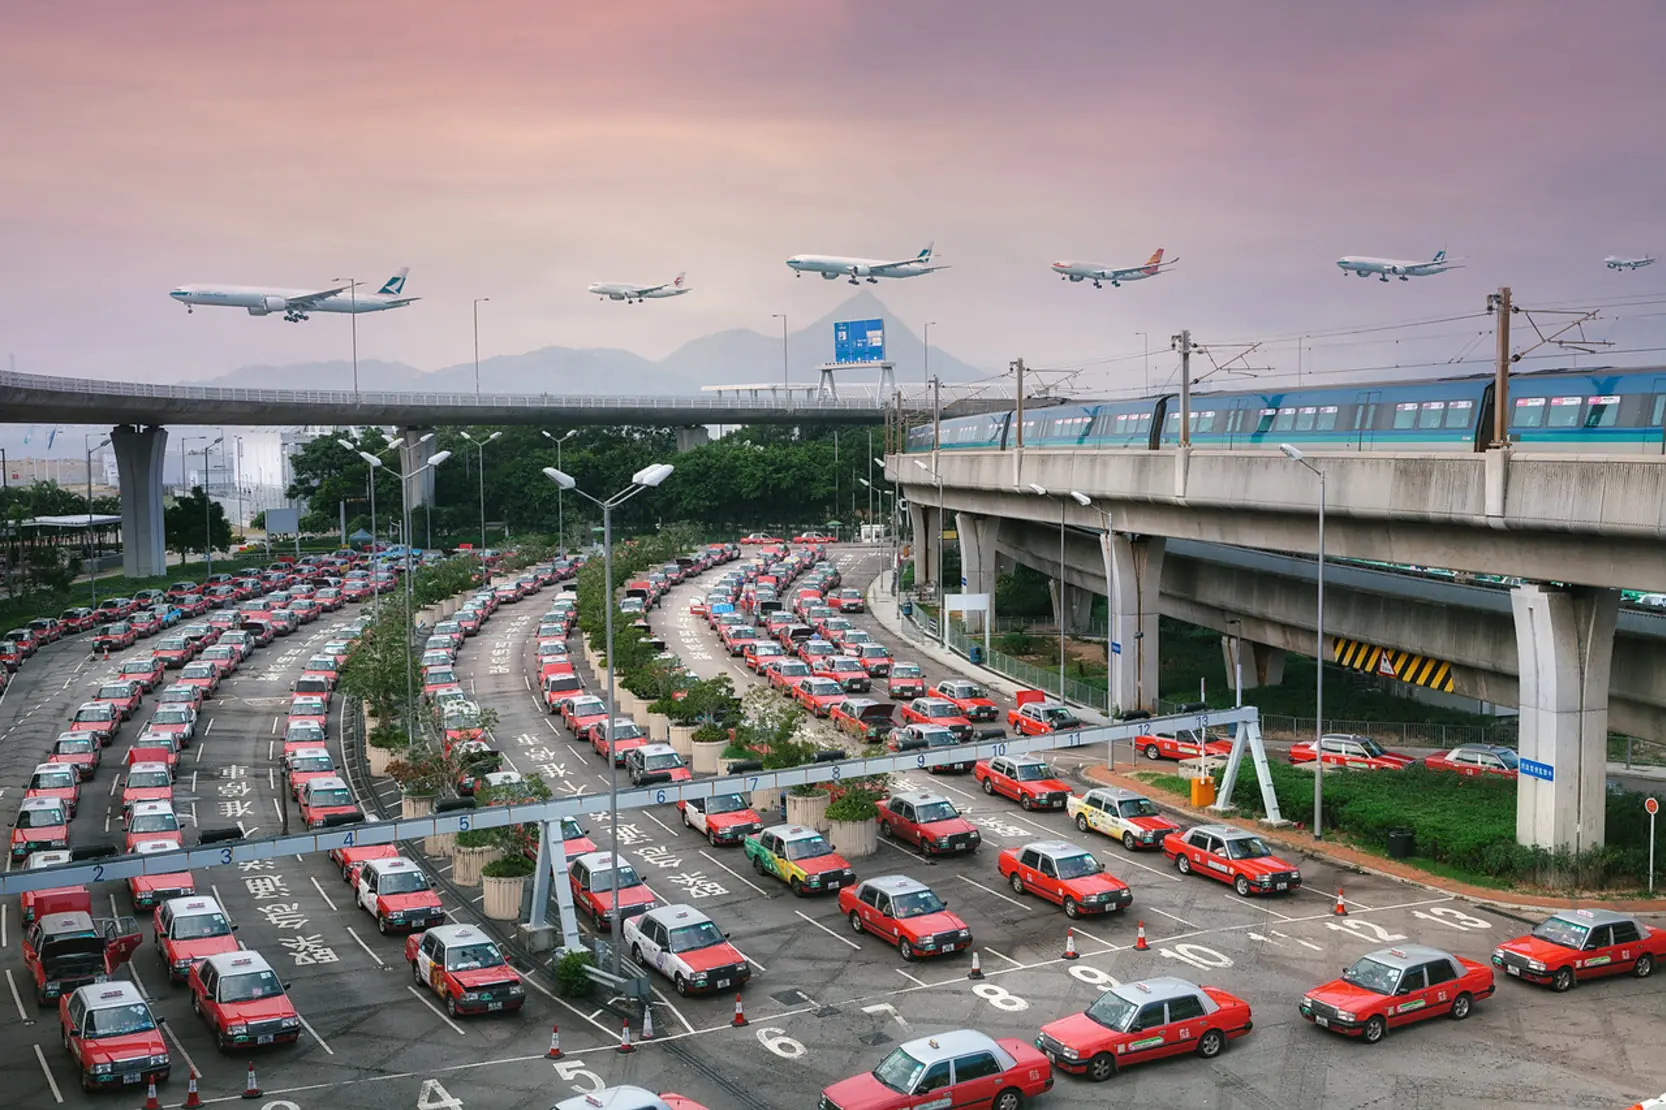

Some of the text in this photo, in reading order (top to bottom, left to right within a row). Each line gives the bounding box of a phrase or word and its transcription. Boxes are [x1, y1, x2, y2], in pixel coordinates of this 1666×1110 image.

[1138, 721, 1151, 736] 12
[1196, 714, 1209, 728] 13
[1068, 731, 1081, 746] 11
[992, 743, 1006, 758] 10
[917, 754, 926, 769] 9
[832, 765, 841, 780] 8
[750, 777, 759, 791] 7
[656, 788, 667, 805] 6
[459, 815, 470, 832] 5
[343, 831, 355, 848] 4
[220, 847, 233, 866] 3
[93, 866, 105, 883] 2
[1412, 907, 1493, 931] 13
[1324, 919, 1408, 943] 12
[1158, 943, 1235, 972] 10
[1068, 965, 1121, 992] 9
[971, 983, 1030, 1012] 8
[860, 1002, 914, 1033] 7
[755, 1026, 808, 1060] 6
[552, 1059, 606, 1094] 5
[417, 1079, 464, 1110] 4
